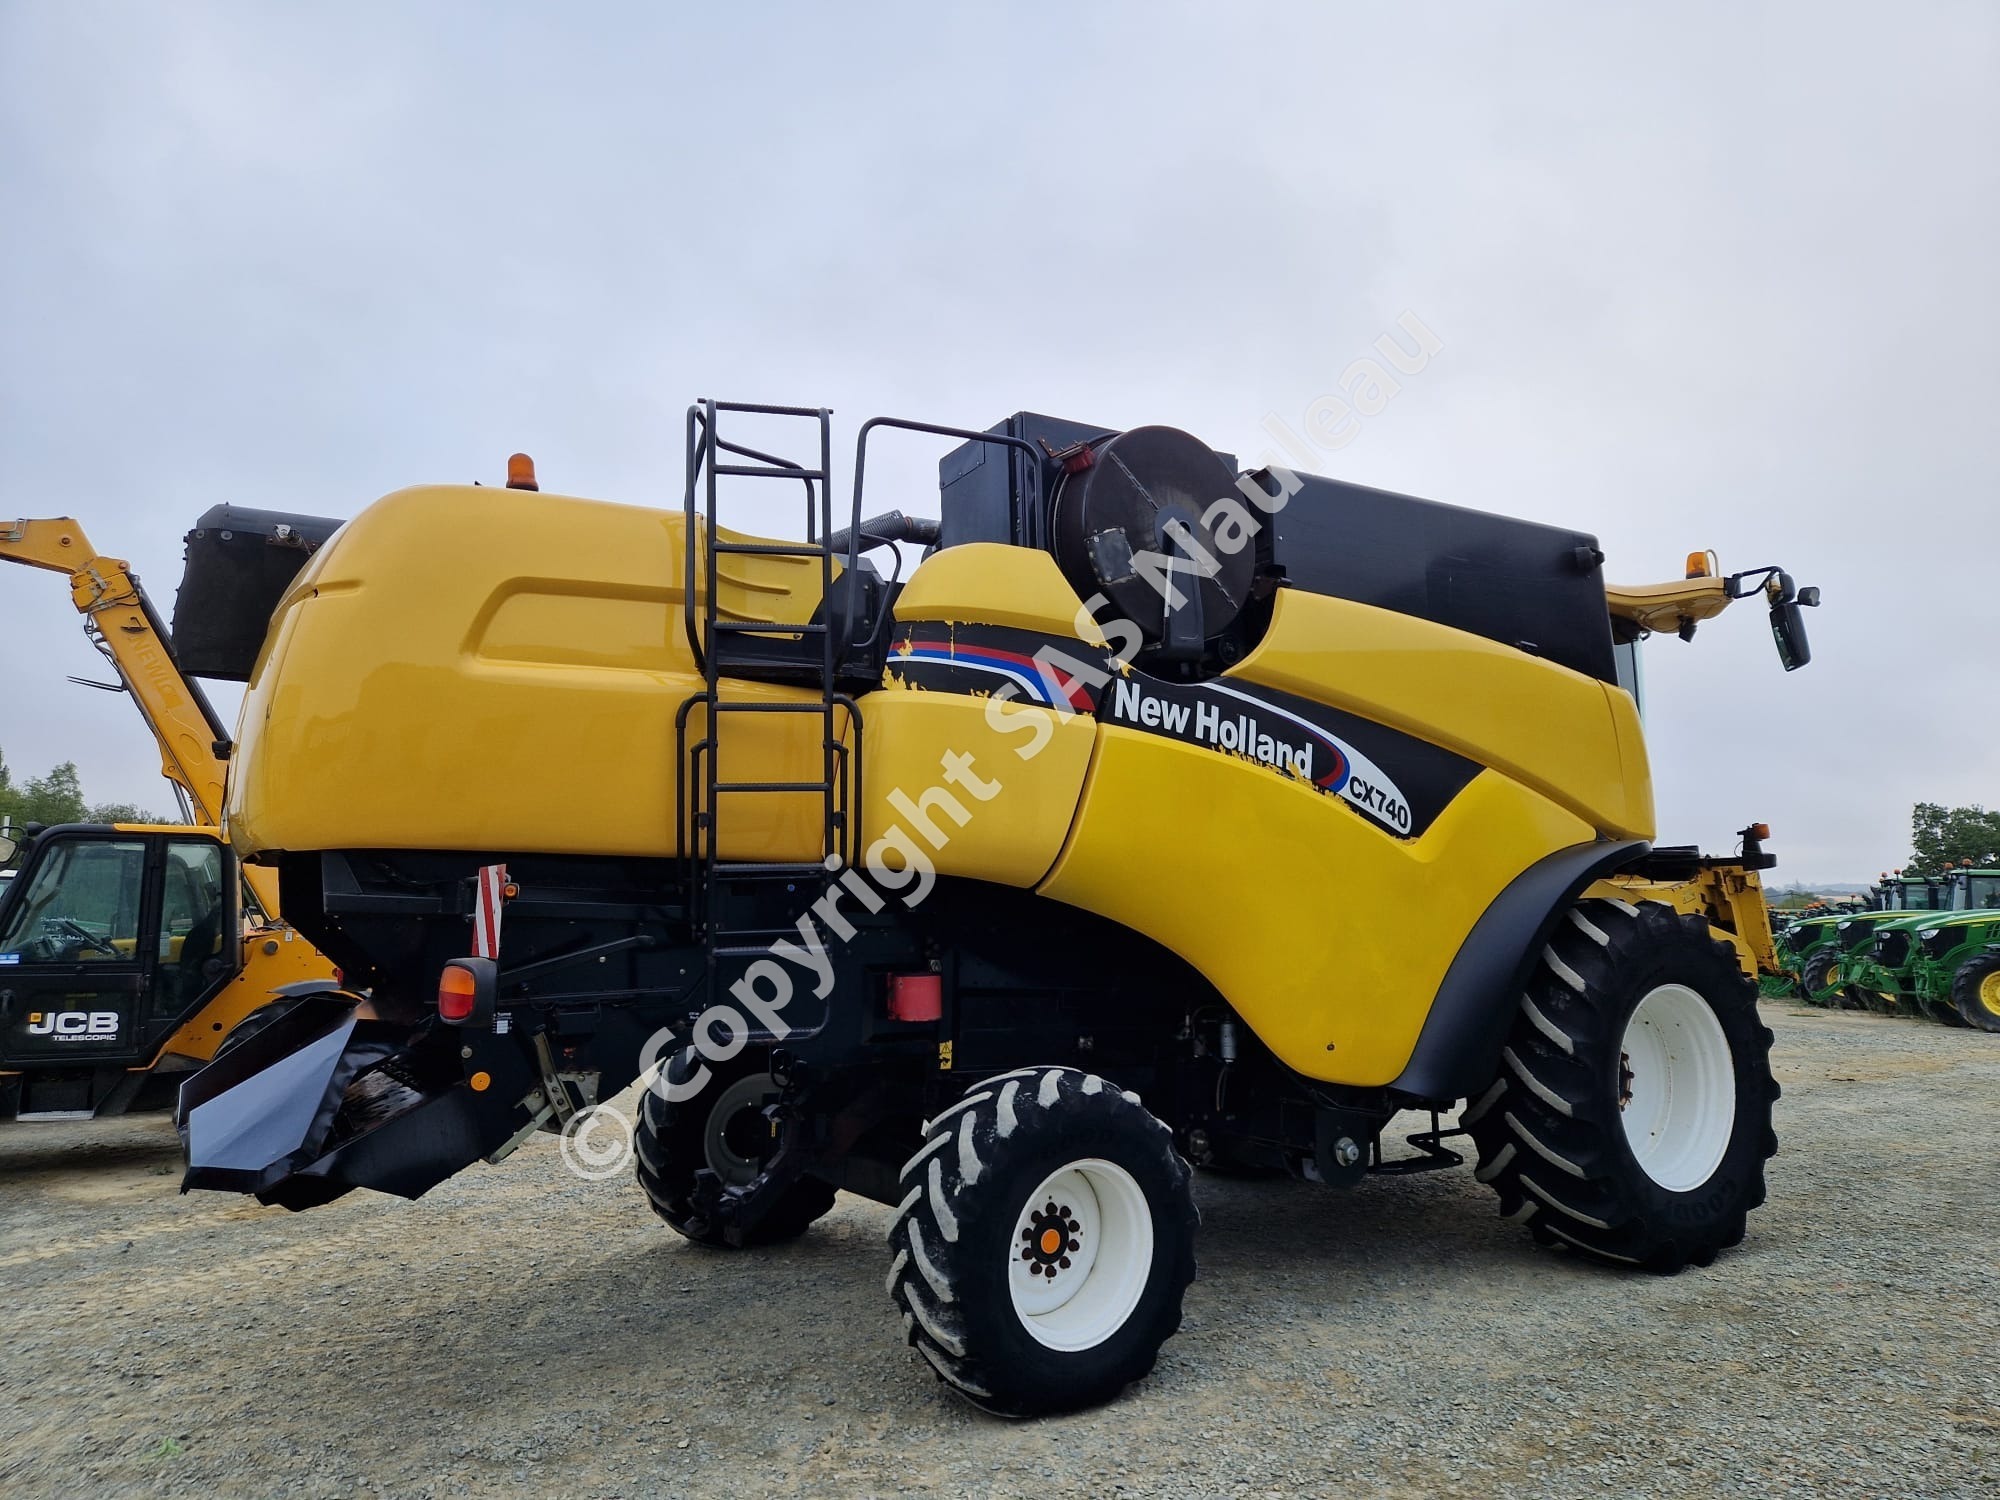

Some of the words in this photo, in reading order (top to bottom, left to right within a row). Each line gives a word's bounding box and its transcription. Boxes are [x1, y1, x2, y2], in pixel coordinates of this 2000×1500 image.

[1114, 678, 1191, 735] New
[1195, 701, 1313, 779] Holland
[1349, 775, 1409, 830] CX740
[29, 1012, 119, 1034] JCB
